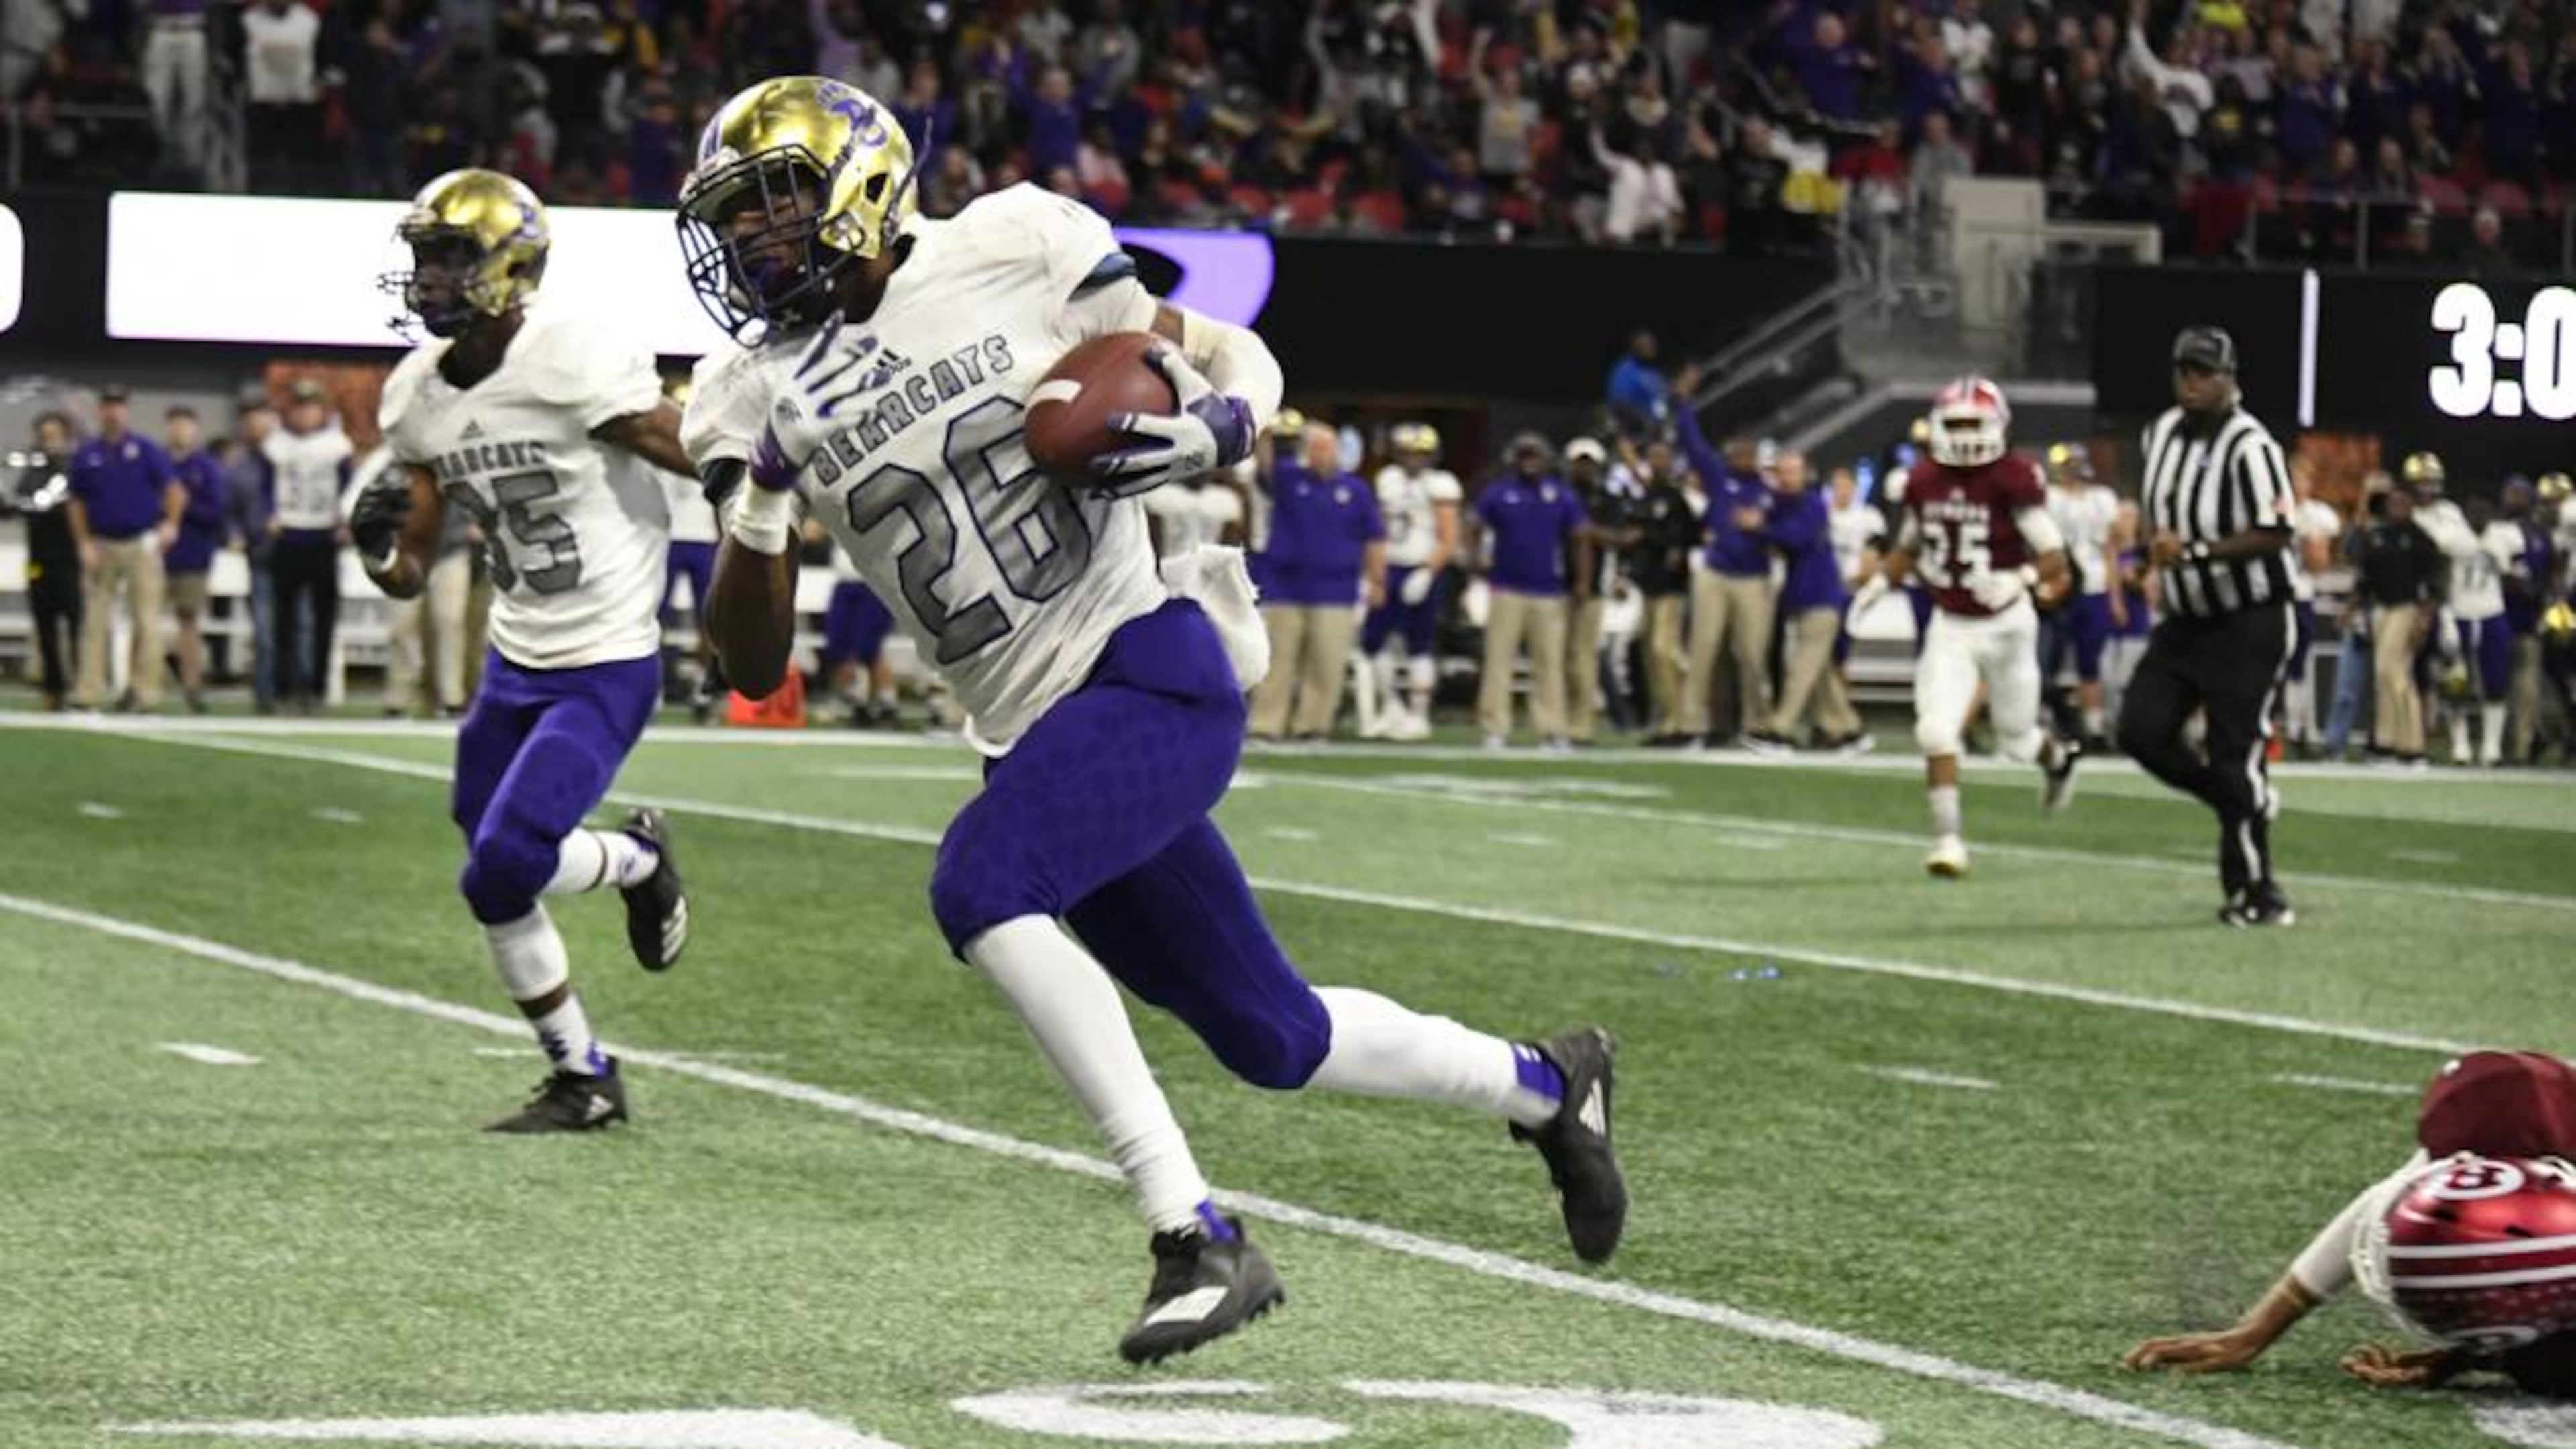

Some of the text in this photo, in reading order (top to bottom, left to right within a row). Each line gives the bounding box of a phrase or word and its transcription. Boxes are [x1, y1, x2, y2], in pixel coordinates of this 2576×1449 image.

[812, 335, 1014, 488] BEARCATS
[2429, 282, 2576, 420] 3:0
[848, 394, 1091, 665] 26
